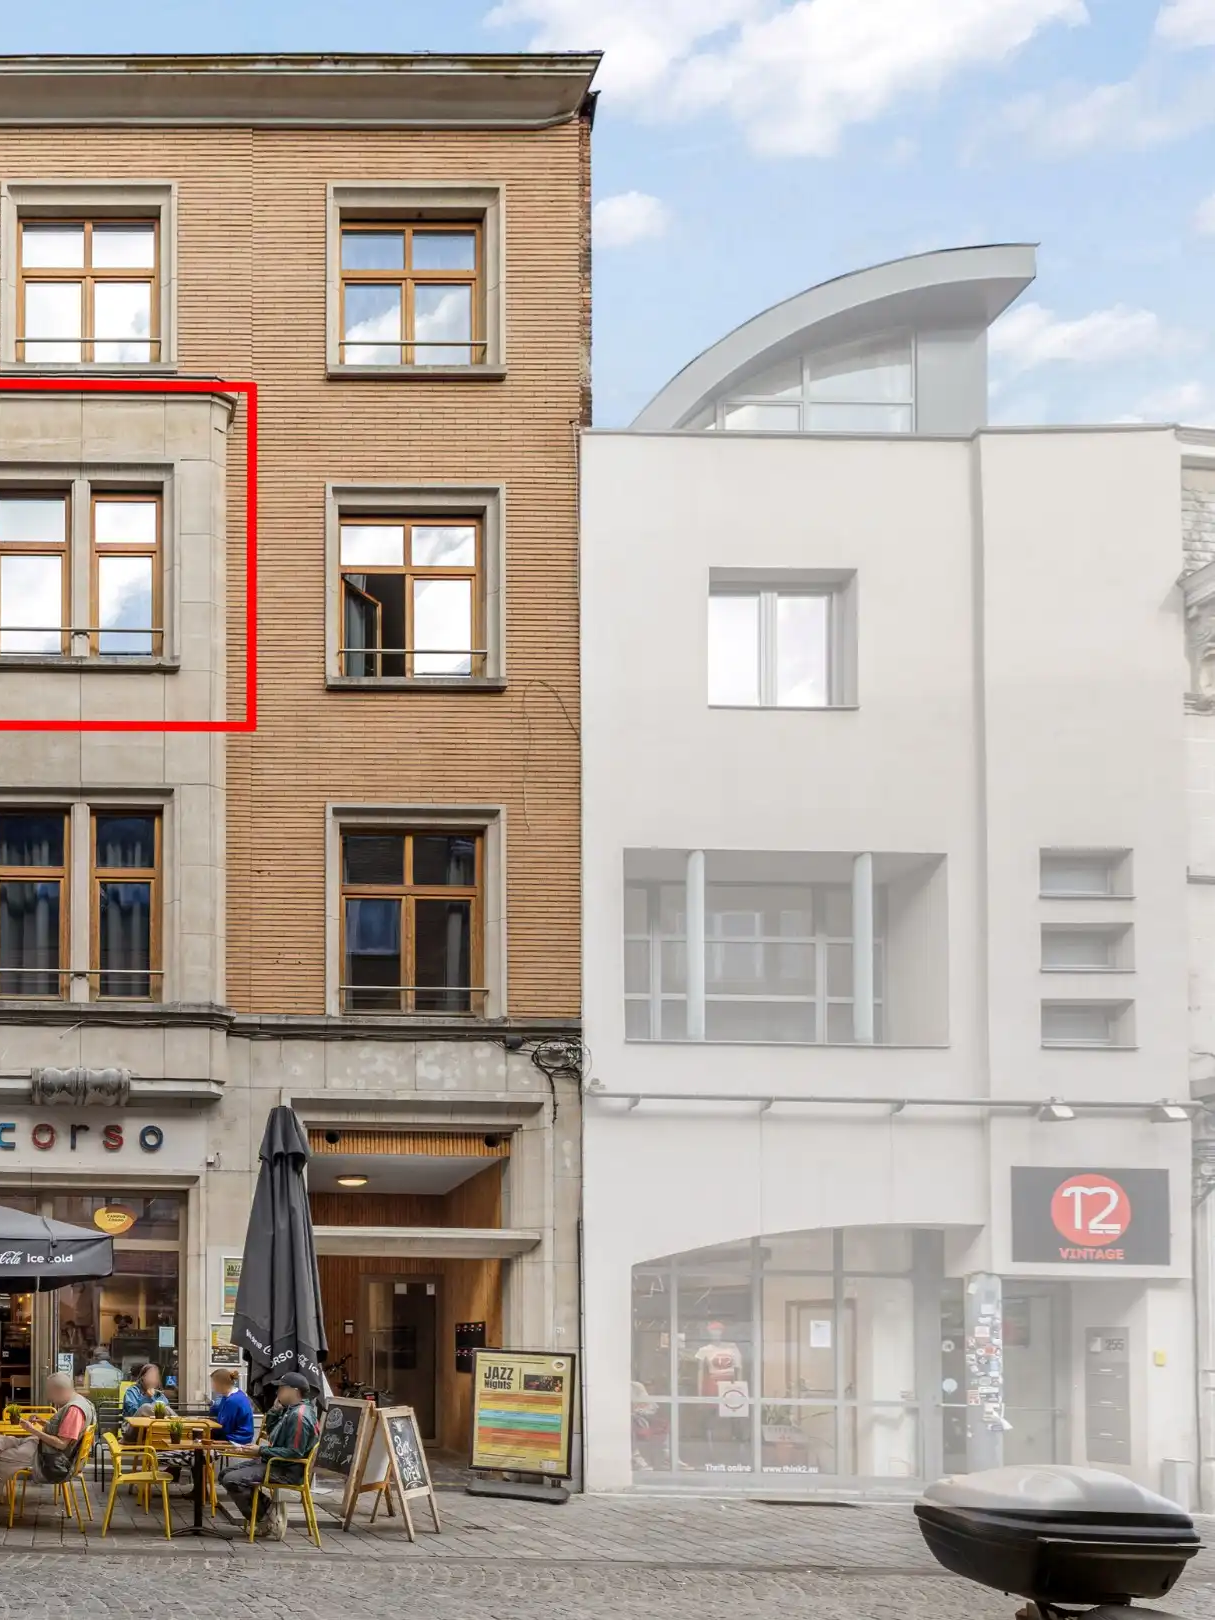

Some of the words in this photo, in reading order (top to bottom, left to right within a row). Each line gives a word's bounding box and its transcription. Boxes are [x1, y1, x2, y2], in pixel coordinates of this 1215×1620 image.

[27, 1254, 44, 1263] ice
[1059, 1247, 1125, 1260] VINTAGE
[1104, 1338, 1124, 1351] 255
[483, 1366, 514, 1381] JAZZ
[484, 1379, 512, 1390] Nights
